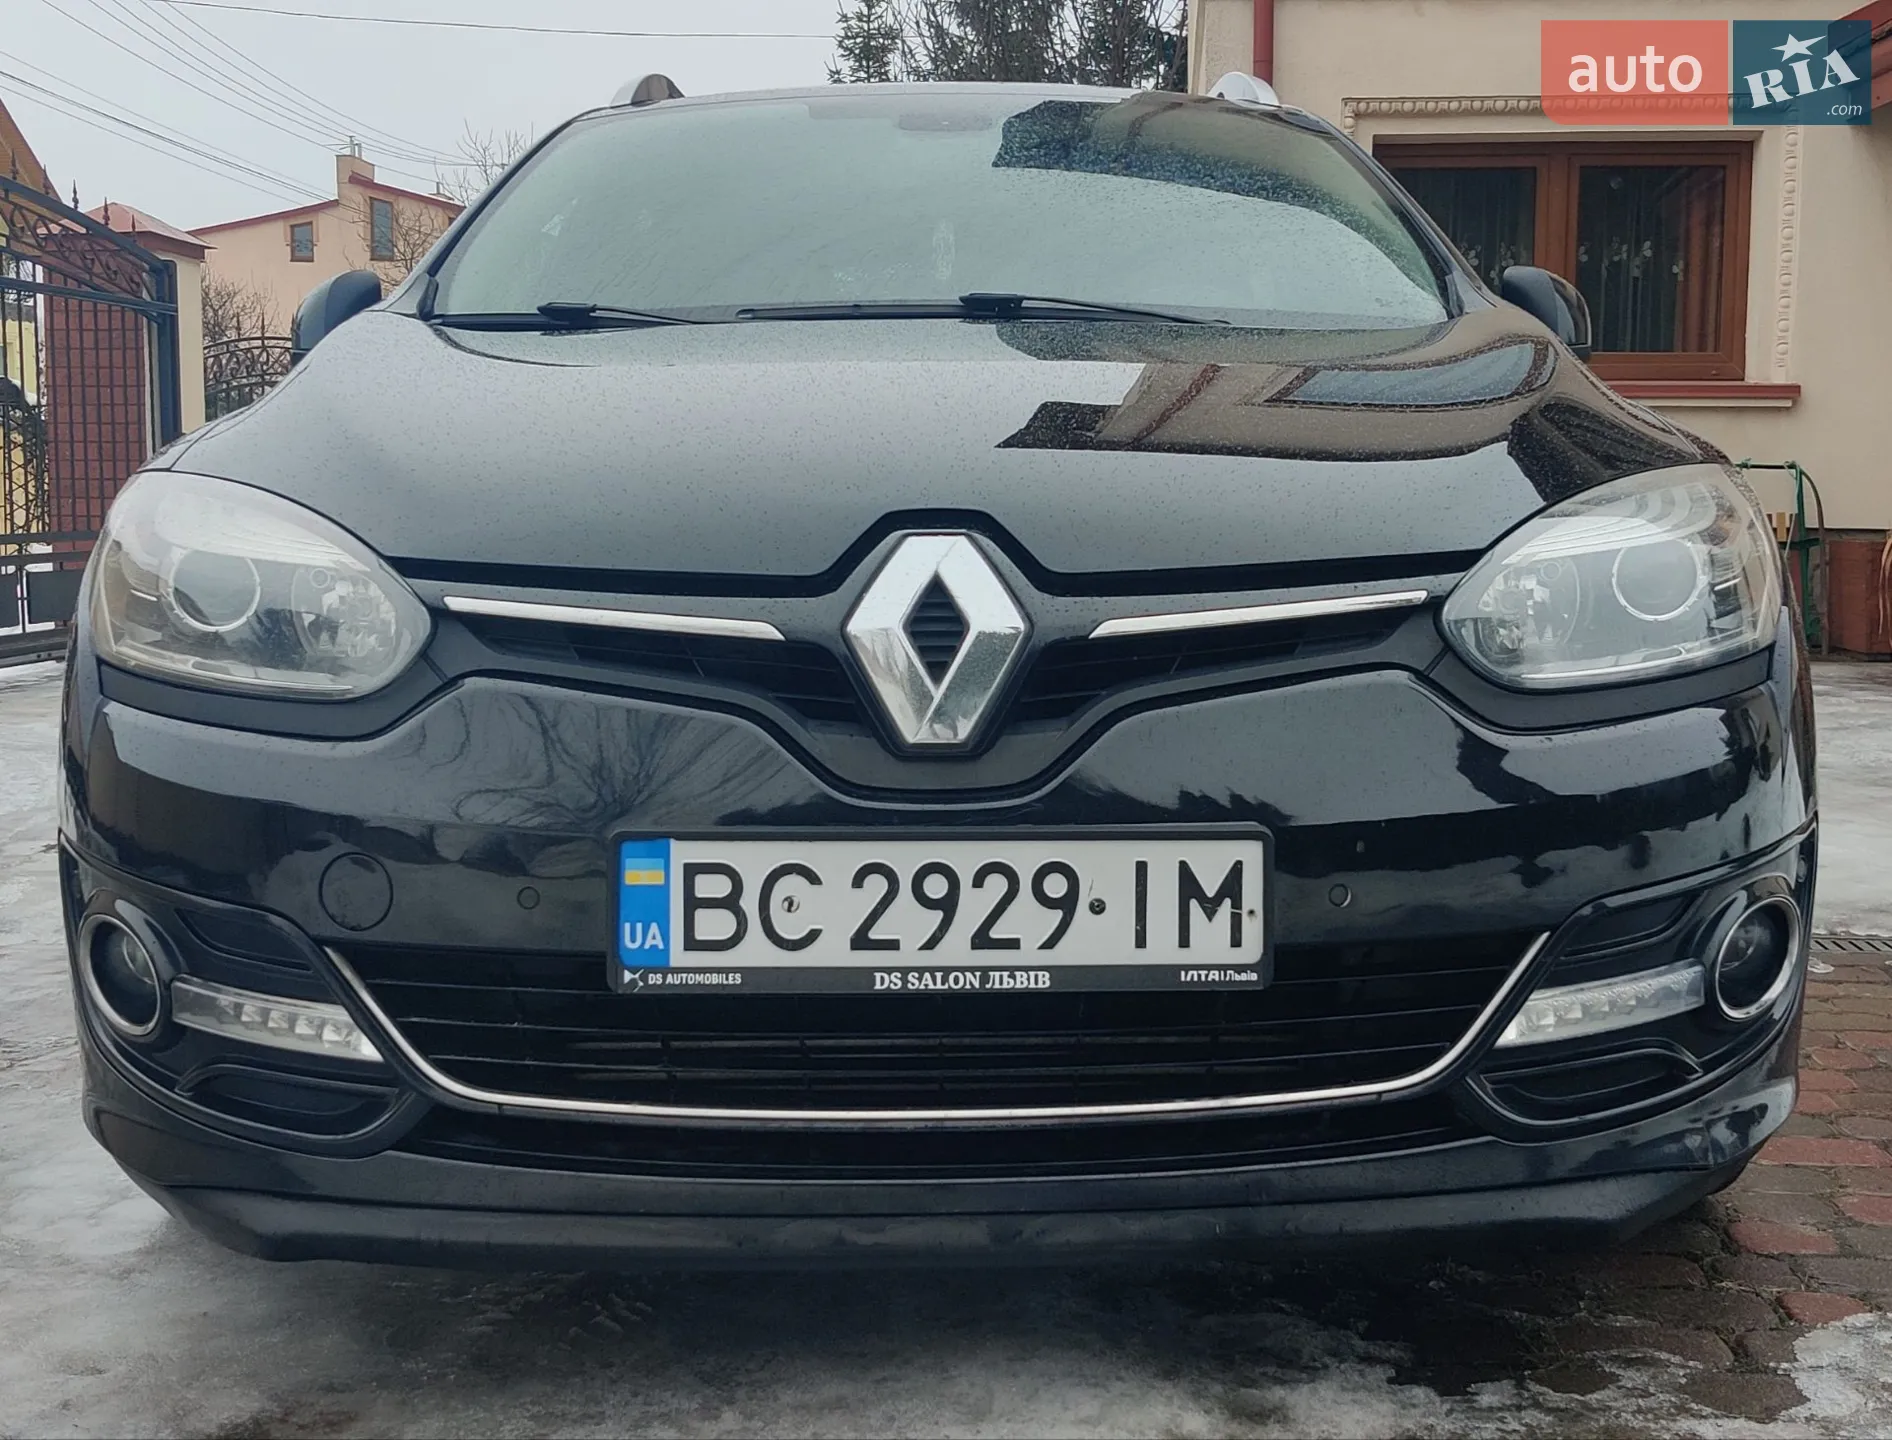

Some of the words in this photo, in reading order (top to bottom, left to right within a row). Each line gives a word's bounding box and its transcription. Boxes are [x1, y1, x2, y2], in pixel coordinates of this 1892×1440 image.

[683, 861, 823, 951] BC
[849, 860, 1080, 951] 2929
[1135, 859, 1244, 949] IM
[624, 921, 665, 950] UA
[647, 973, 663, 985] DS
[665, 973, 742, 985] AUTOMOBILES
[873, 972, 902, 990] DS
[907, 972, 981, 990] SALON
[985, 971, 1051, 989] ЛЬВІВ
